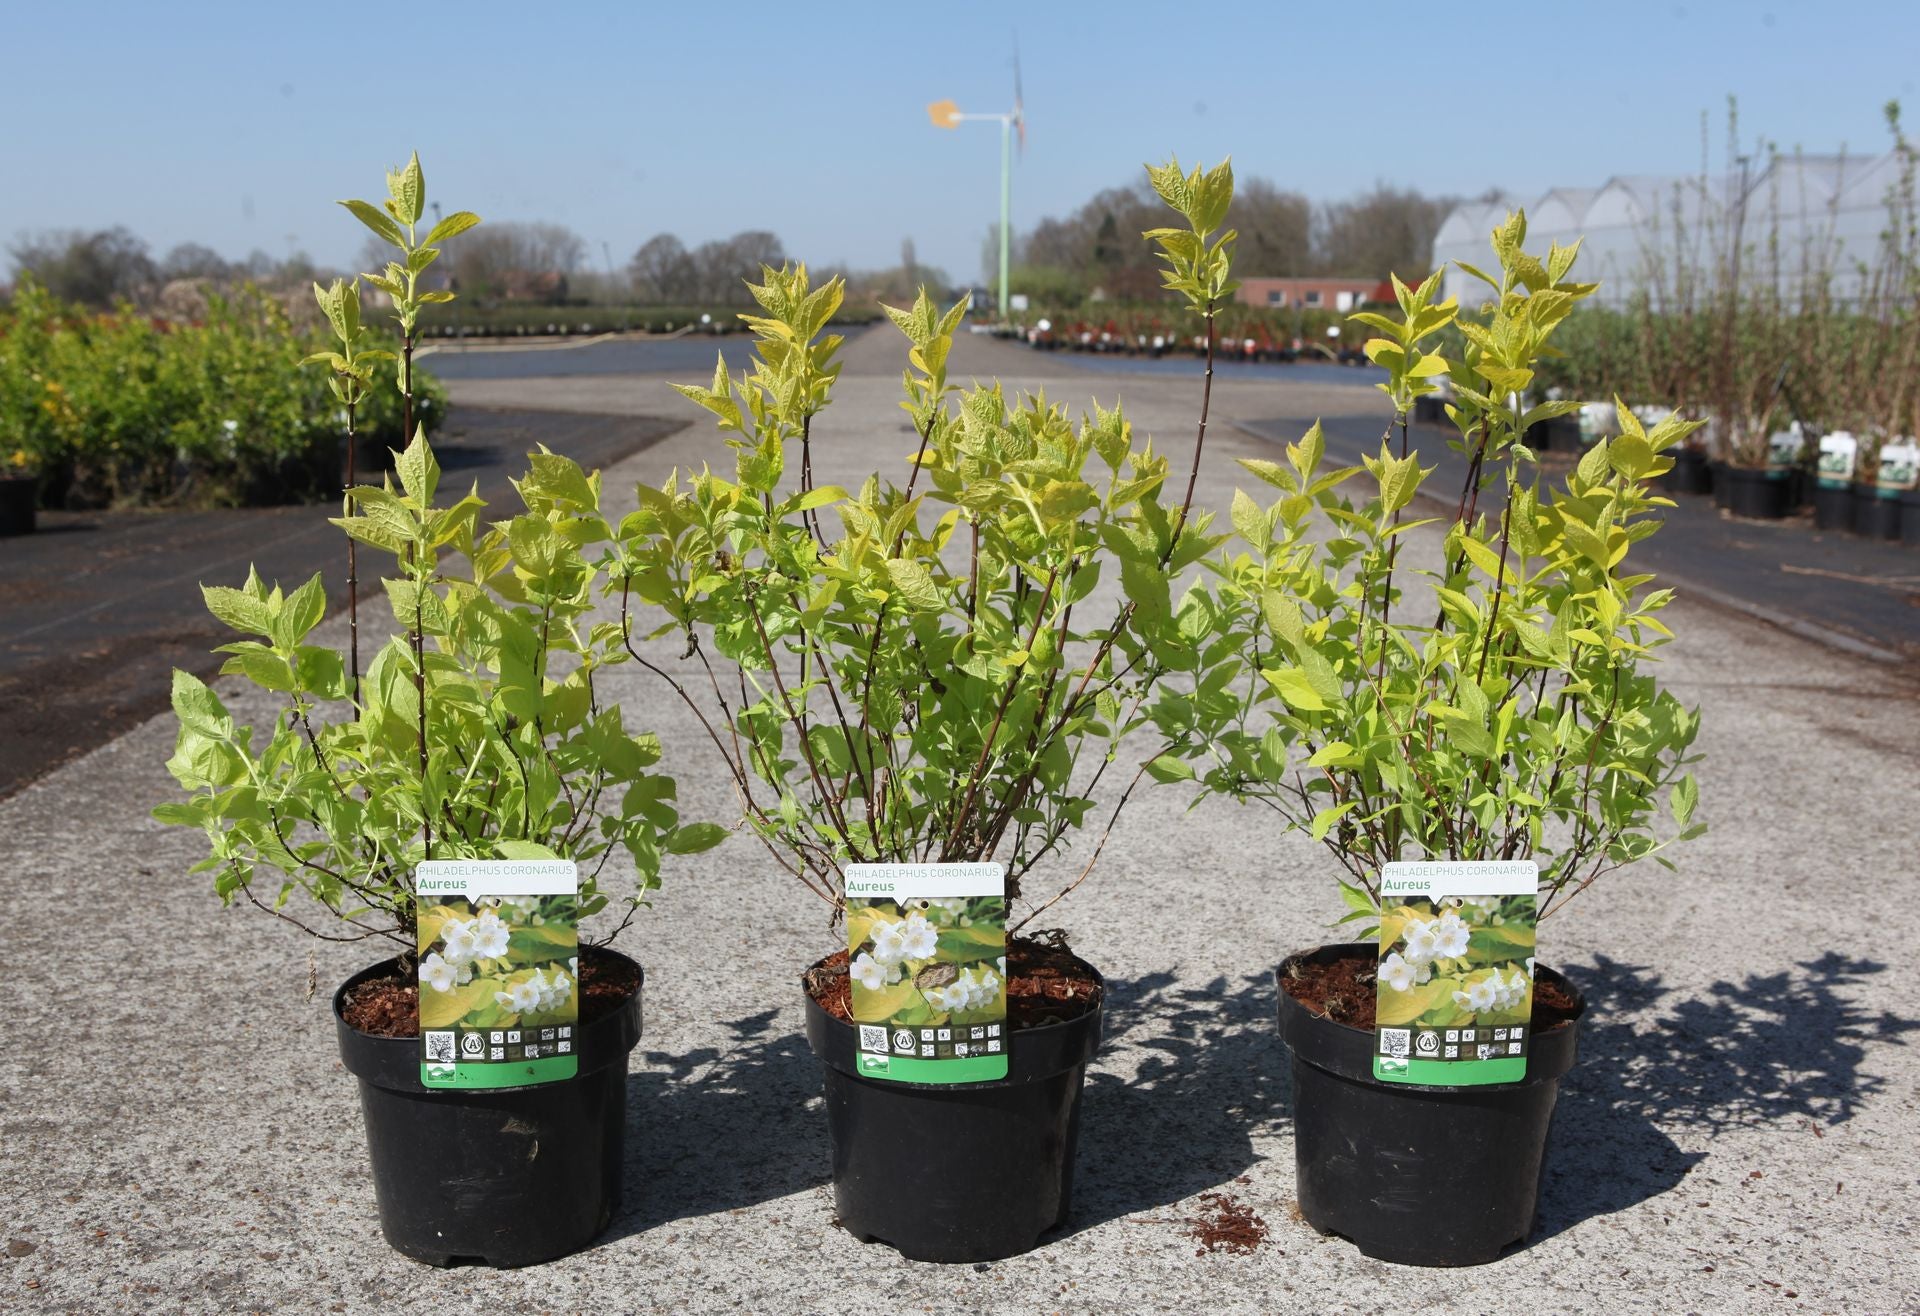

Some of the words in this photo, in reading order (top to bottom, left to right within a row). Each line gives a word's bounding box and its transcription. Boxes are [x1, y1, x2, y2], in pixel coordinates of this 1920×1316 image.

[419, 866, 500, 876] PHILADELPHUS
[503, 865, 573, 875] CORONARIUS
[847, 869, 927, 879] PHILADELPHUS
[930, 867, 999, 878] CORONARIUS
[1384, 866, 1464, 877] PHILADELPHUS
[1466, 865, 1534, 876] CORONARIUS
[419, 878, 467, 889] Aureus
[847, 881, 895, 892] Aureus
[1384, 879, 1431, 890] Aureus
